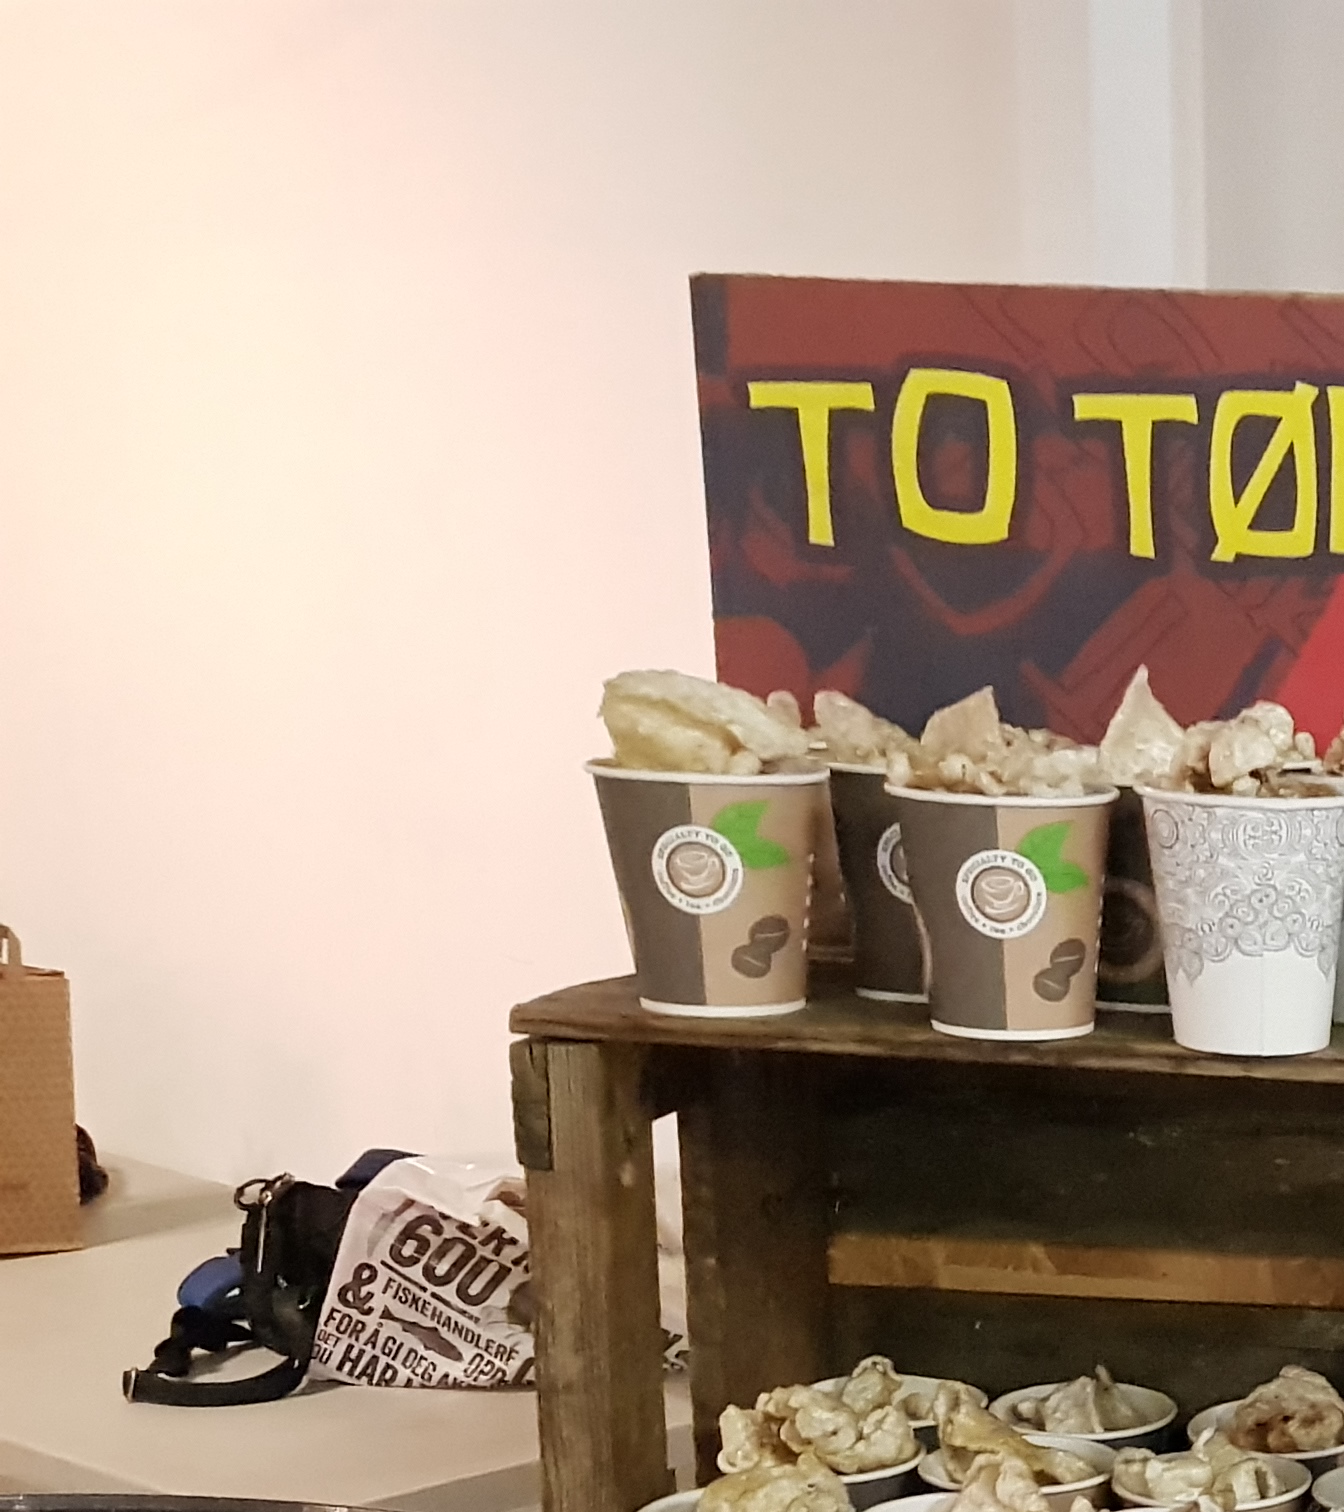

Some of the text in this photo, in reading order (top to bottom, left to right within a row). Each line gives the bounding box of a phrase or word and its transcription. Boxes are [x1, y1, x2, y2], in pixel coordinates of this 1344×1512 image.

[747, 366, 1018, 547] TO
[337, 1262, 379, 1316] &
[323, 1307, 366, 1343] FOR
[381, 1335, 404, 1361] GI
[401, 1347, 437, 1384] DEG
